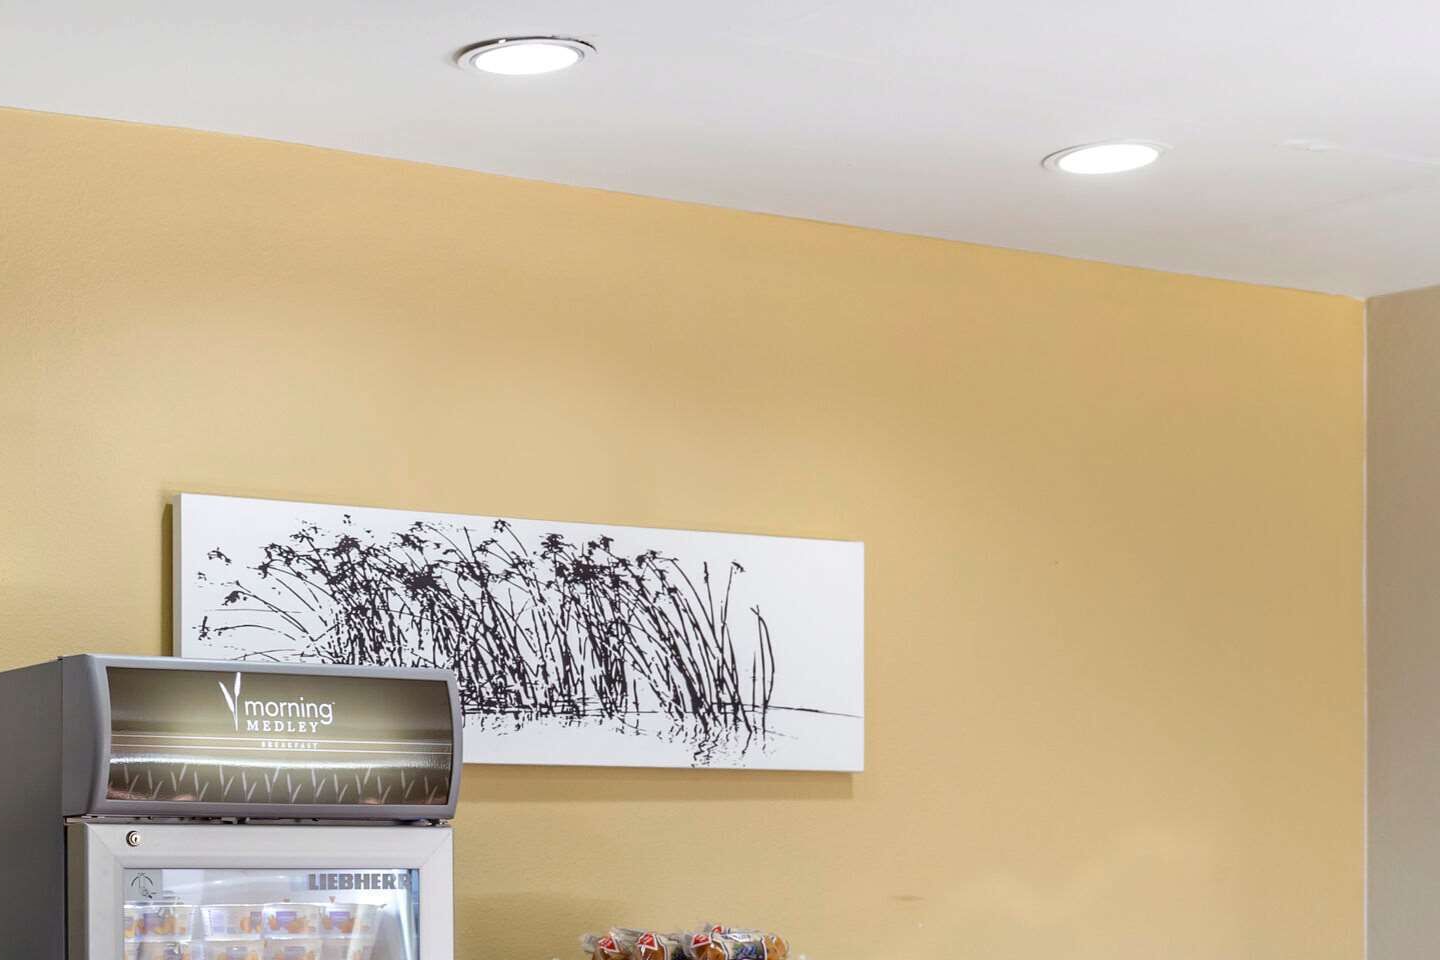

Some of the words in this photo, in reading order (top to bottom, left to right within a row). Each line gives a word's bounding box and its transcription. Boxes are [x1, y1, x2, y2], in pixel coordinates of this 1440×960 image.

[244, 696, 333, 725] morning
[247, 720, 318, 733] MEDLEY
[261, 741, 320, 750] BREAKFAST
[308, 873, 410, 890] LIEBHERR
